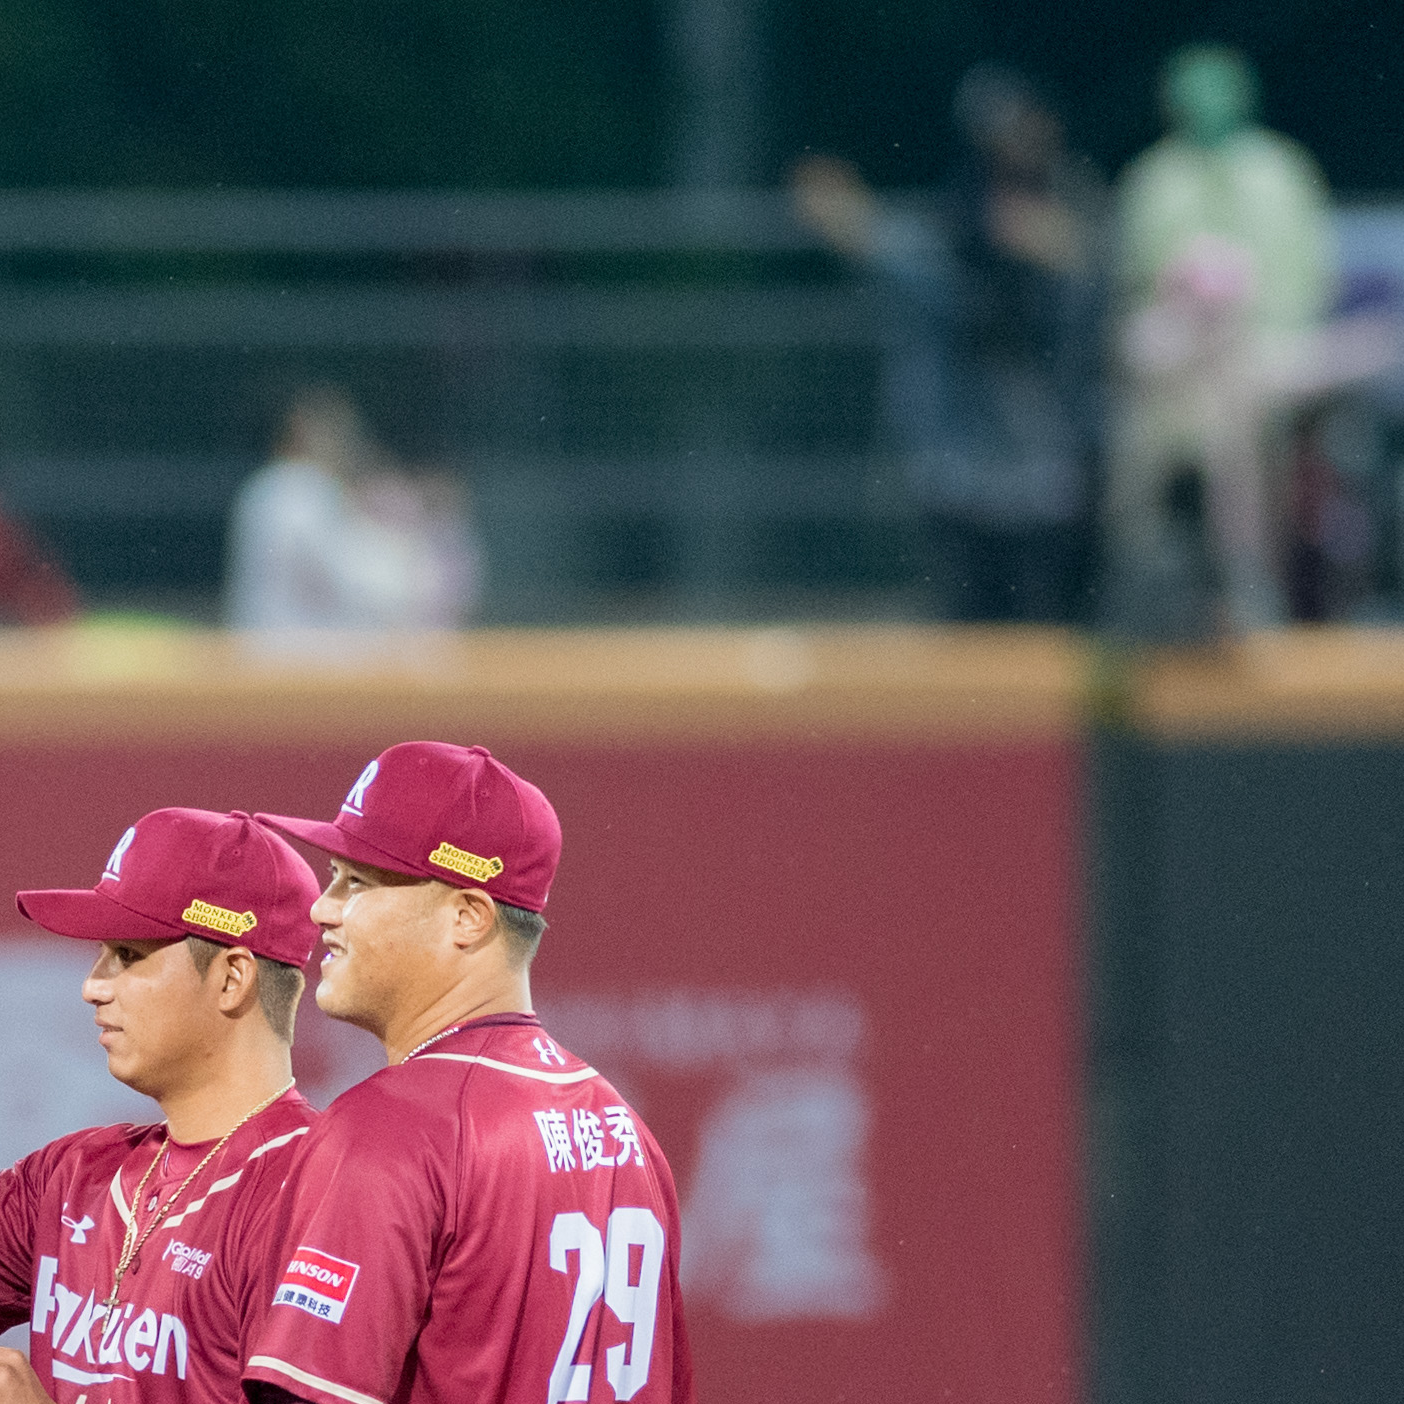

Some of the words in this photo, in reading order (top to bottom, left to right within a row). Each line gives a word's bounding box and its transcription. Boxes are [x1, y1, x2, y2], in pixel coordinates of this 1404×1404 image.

[346, 760, 379, 810] R
[105, 826, 135, 875] R
[440, 844, 488, 868] MONKEY
[431, 851, 488, 880] SHOULDER
[184, 910, 242, 935] SHOULDER
[192, 901, 241, 923] MONKEY
[532, 1105, 645, 1173] 陳俊秀
